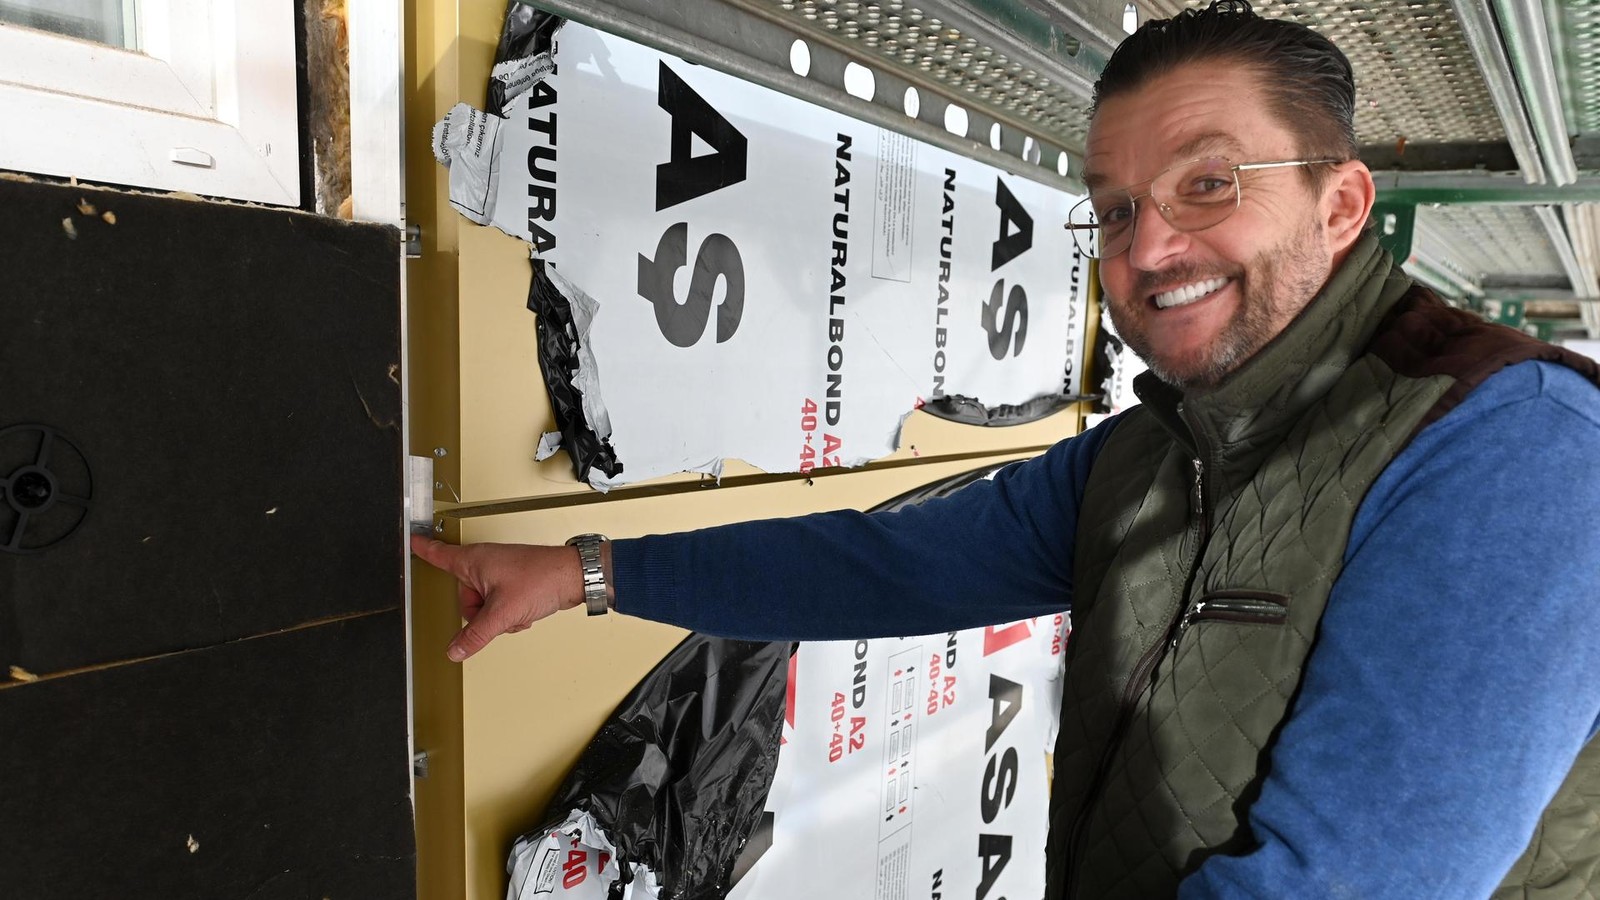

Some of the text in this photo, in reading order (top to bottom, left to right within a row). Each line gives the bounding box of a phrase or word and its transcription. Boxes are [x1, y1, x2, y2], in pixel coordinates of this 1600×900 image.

[527, 41, 558, 269] ATURA
[637, 59, 748, 347] AŞ
[822, 132, 853, 467] NATURALBOND A2
[932, 168, 957, 396] NATURALBON
[981, 174, 1034, 361] AŞ
[829, 692, 846, 763] 40+40
[848, 639, 869, 754] OND A2
[928, 655, 942, 715] 40+40
[942, 675, 957, 709] A2
[976, 674, 1022, 900] ASA
